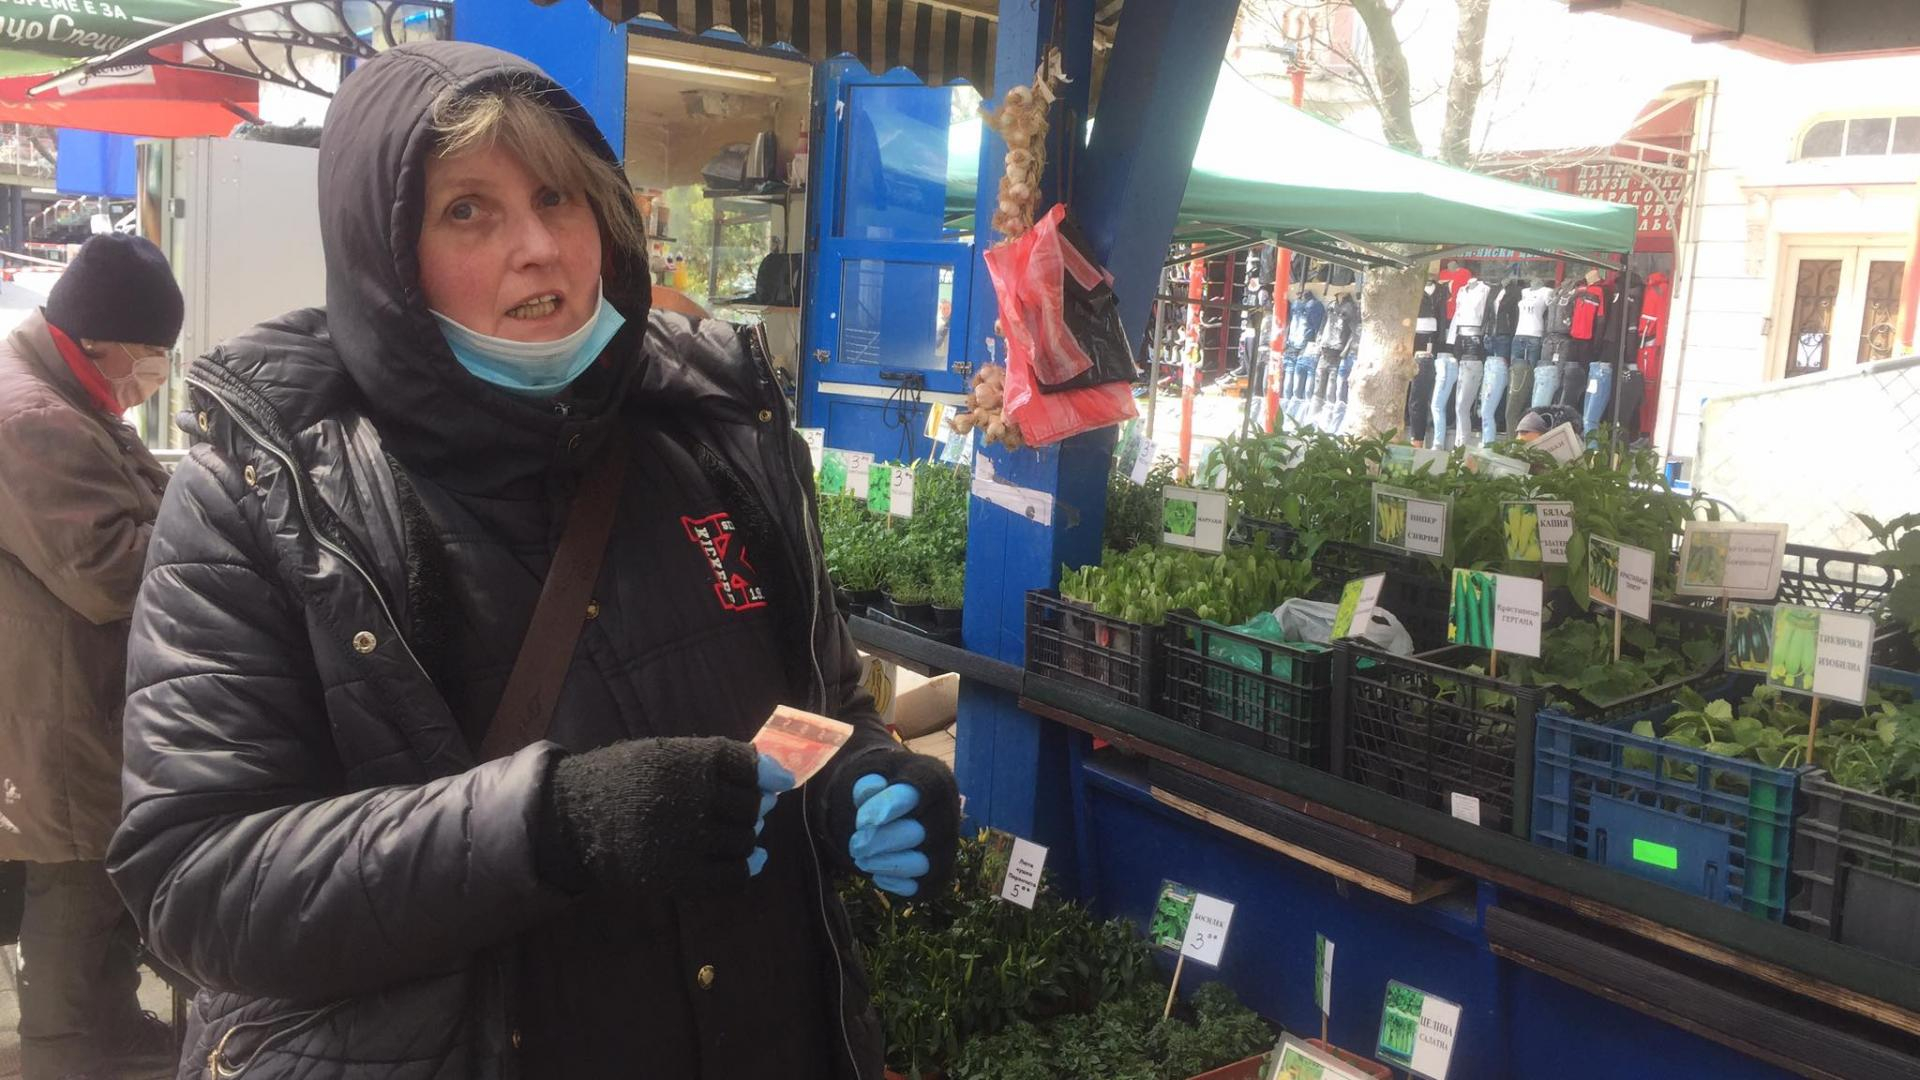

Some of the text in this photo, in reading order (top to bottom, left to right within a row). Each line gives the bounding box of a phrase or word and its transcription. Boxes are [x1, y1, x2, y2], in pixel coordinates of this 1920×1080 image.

[102, 3, 127, 20] ЗА
[1578, 178, 1630, 192] БЛУЗИ
[1540, 519, 1569, 528] КАПИЯ
[1502, 615, 1534, 627] ГЕРГАНА
[1420, 1016, 1453, 1037] ЦЕЛИНА
